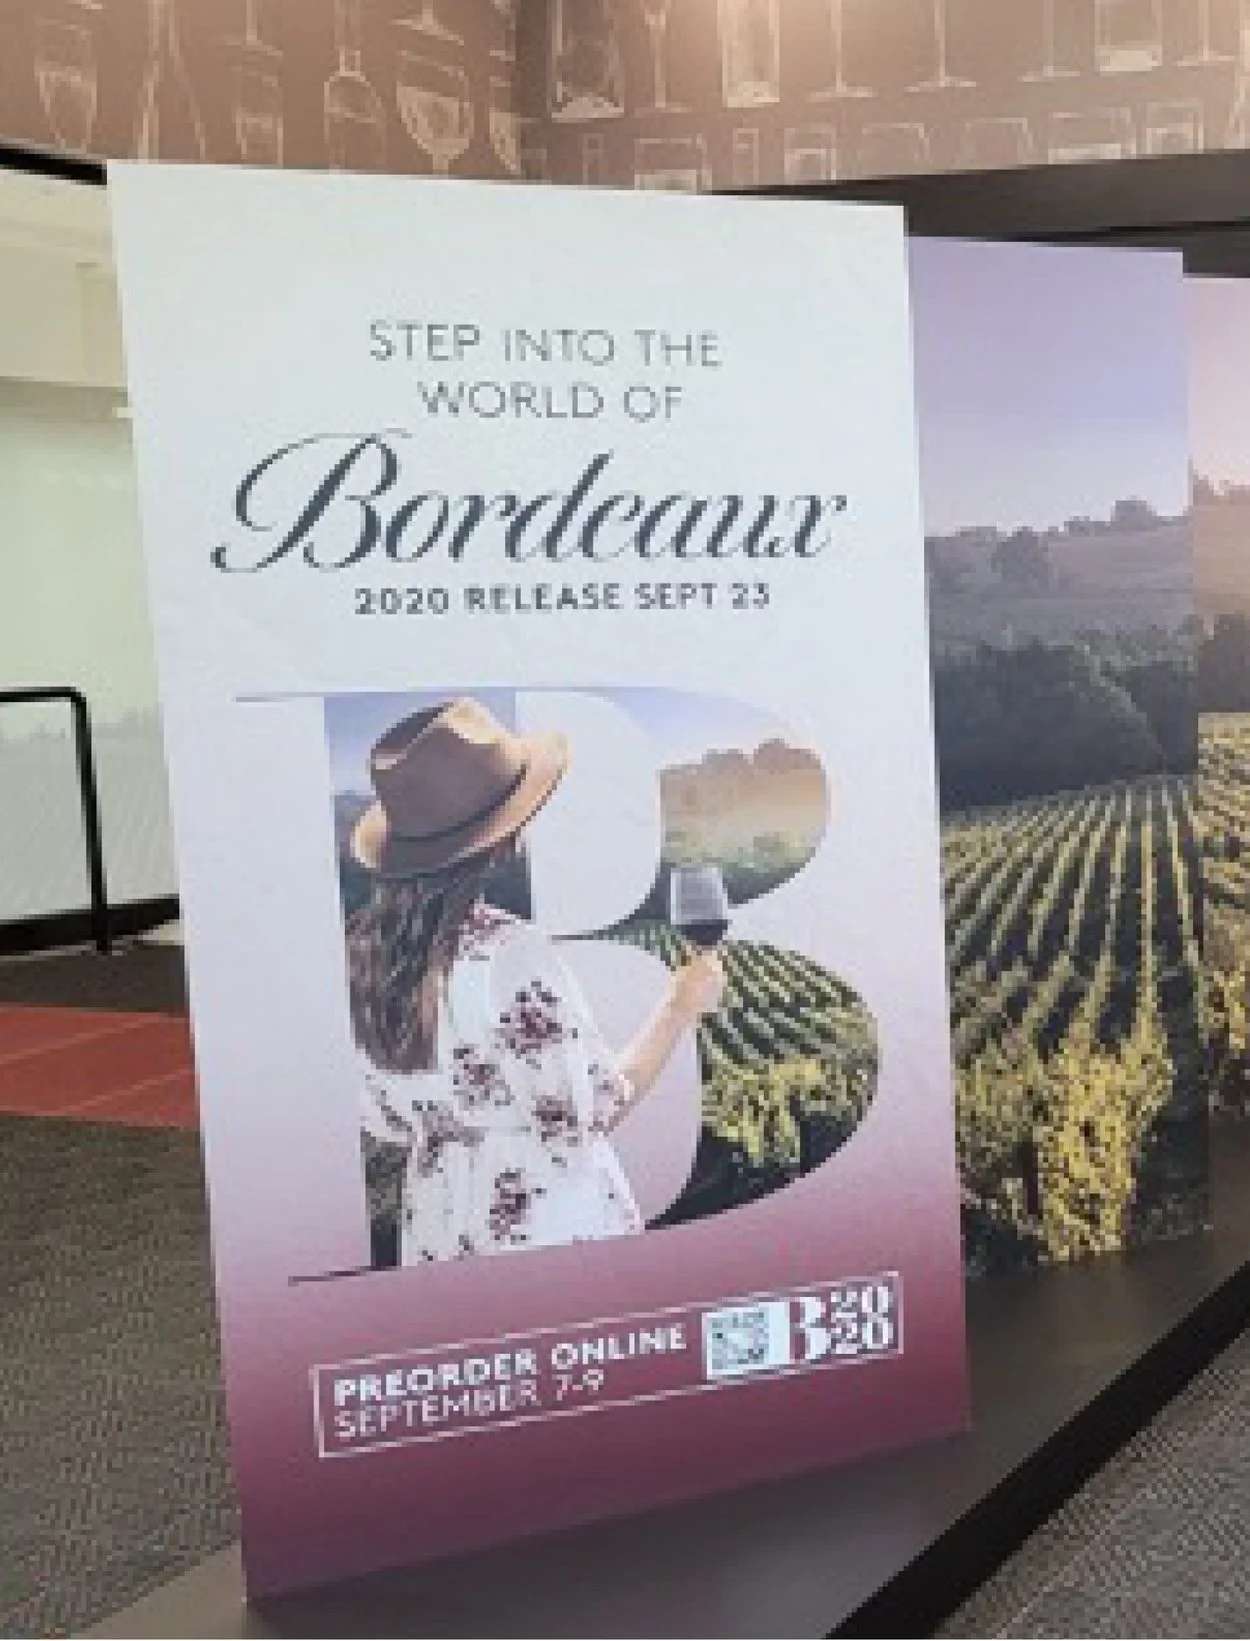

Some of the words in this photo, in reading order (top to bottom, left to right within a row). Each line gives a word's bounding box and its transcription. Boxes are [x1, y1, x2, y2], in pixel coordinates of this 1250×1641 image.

[368, 319, 482, 362] STEP
[502, 328, 616, 366] INTO
[634, 330, 722, 367] THE
[416, 380, 604, 421] WORLD
[621, 384, 684, 423] OF
[209, 428, 848, 573] Bordeaux
[353, 588, 451, 616] 2020
[465, 584, 622, 612] RELEASE
[634, 582, 718, 611] SEPT
[729, 581, 772, 609] 23
[332, 1348, 539, 1407] PREORDER
[550, 1322, 688, 1367] ONLINE
[333, 1384, 539, 1440] SEPTEMBER
[553, 1369, 606, 1402] 7-9
